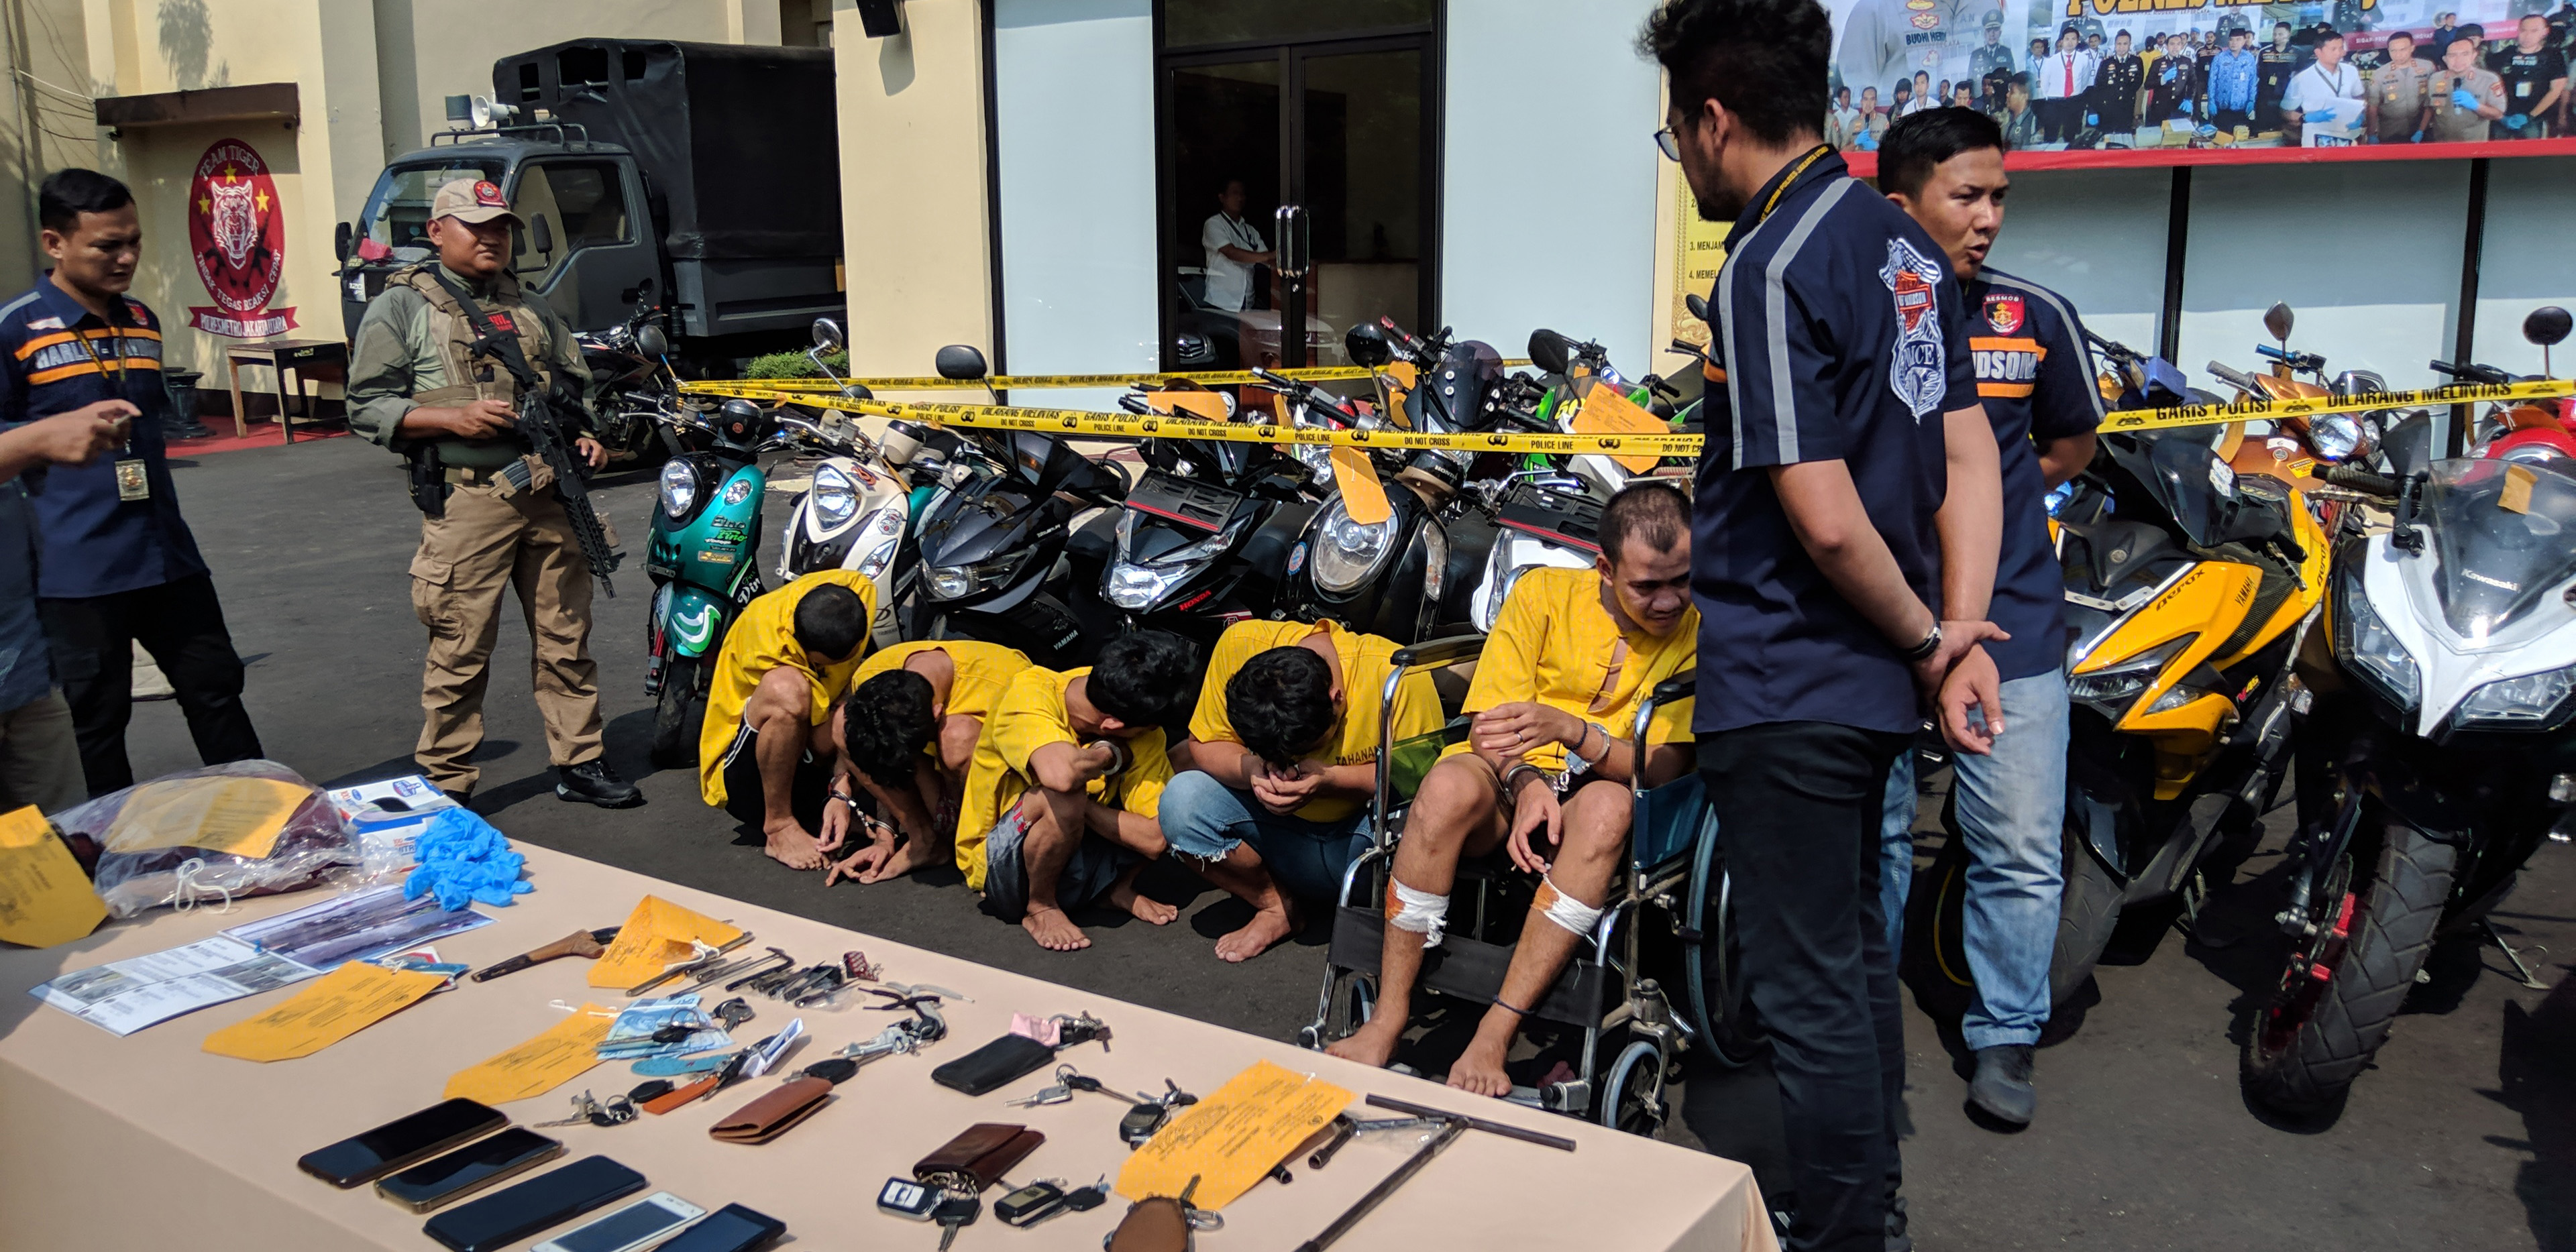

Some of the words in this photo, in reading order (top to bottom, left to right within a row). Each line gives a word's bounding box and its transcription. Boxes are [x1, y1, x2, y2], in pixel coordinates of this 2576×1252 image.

[1906, 33, 1930, 46] BUDHI
[199, 146, 227, 181] TEAM
[228, 145, 260, 176] TIGER
[1697, 240, 1724, 251] MENJAM
[217, 288, 242, 311] TEGAS
[243, 284, 270, 311] REAKSI
[268, 248, 282, 284] CEPAT
[1696, 269, 1717, 279] MEMEL
[2156, 403, 2208, 420] GARIS
[1114, 424, 1125, 433] LINE
[1188, 428, 1195, 436] DO
[1208, 429, 1227, 437] CROSS
[1295, 433, 1316, 441] POLICE
[1318, 434, 1331, 442] LINE
[1405, 437, 1413, 445] DO
[1415, 437, 1427, 446] NOT
[1429, 437, 1450, 446] CROSS
[1530, 439, 1556, 449] POLICE
[1558, 441, 1574, 450] LINE
[1662, 444, 1673, 452] DO
[1674, 444, 1690, 453] NOT
[1434, 465, 1458, 481] HONDA
[2461, 568, 2520, 591] Kawasaki
[2235, 576, 2255, 608] YAMAHA
[1179, 590, 1212, 611] HONDA
[1053, 630, 1079, 650] YAMAHA
[1335, 744, 1378, 766] TAHANA
